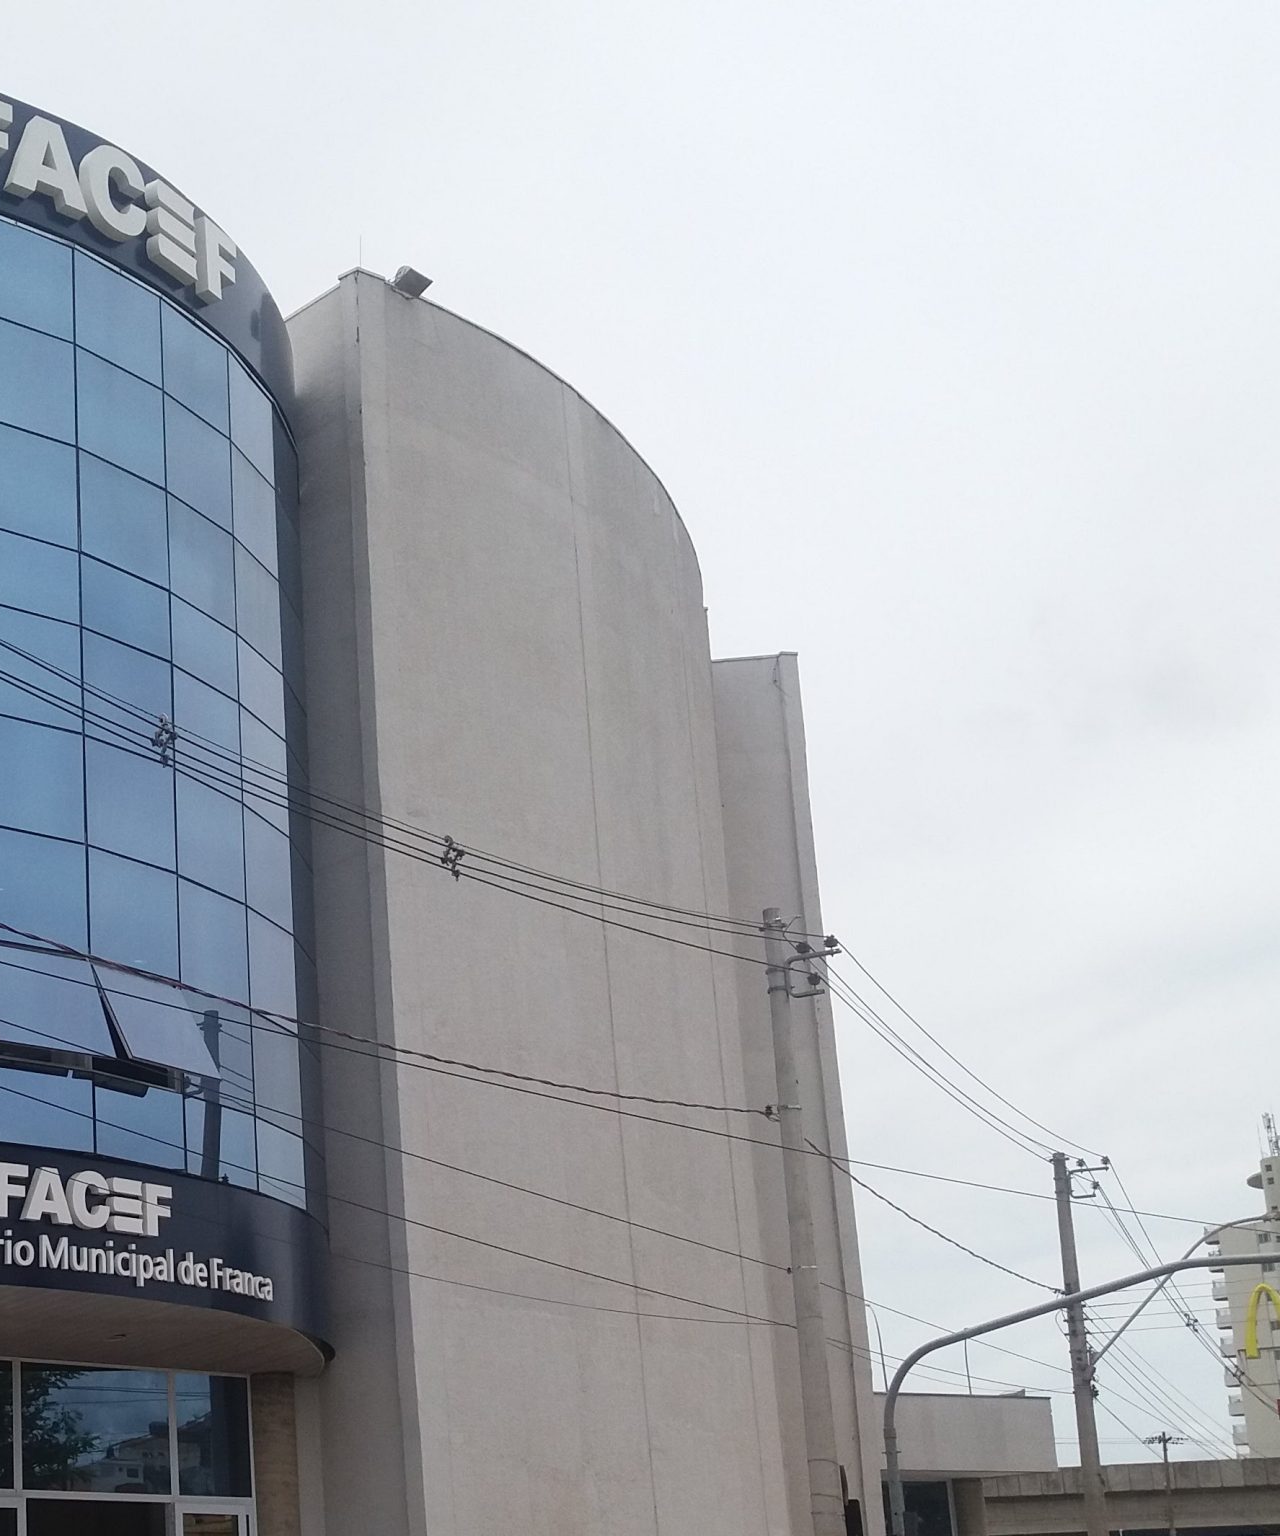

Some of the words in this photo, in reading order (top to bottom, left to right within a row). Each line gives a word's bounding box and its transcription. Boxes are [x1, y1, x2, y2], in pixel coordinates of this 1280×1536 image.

[38, 1234, 175, 1287] Municipal
[177, 1258, 208, 1288] de
[208, 1257, 275, 1302] Franca
